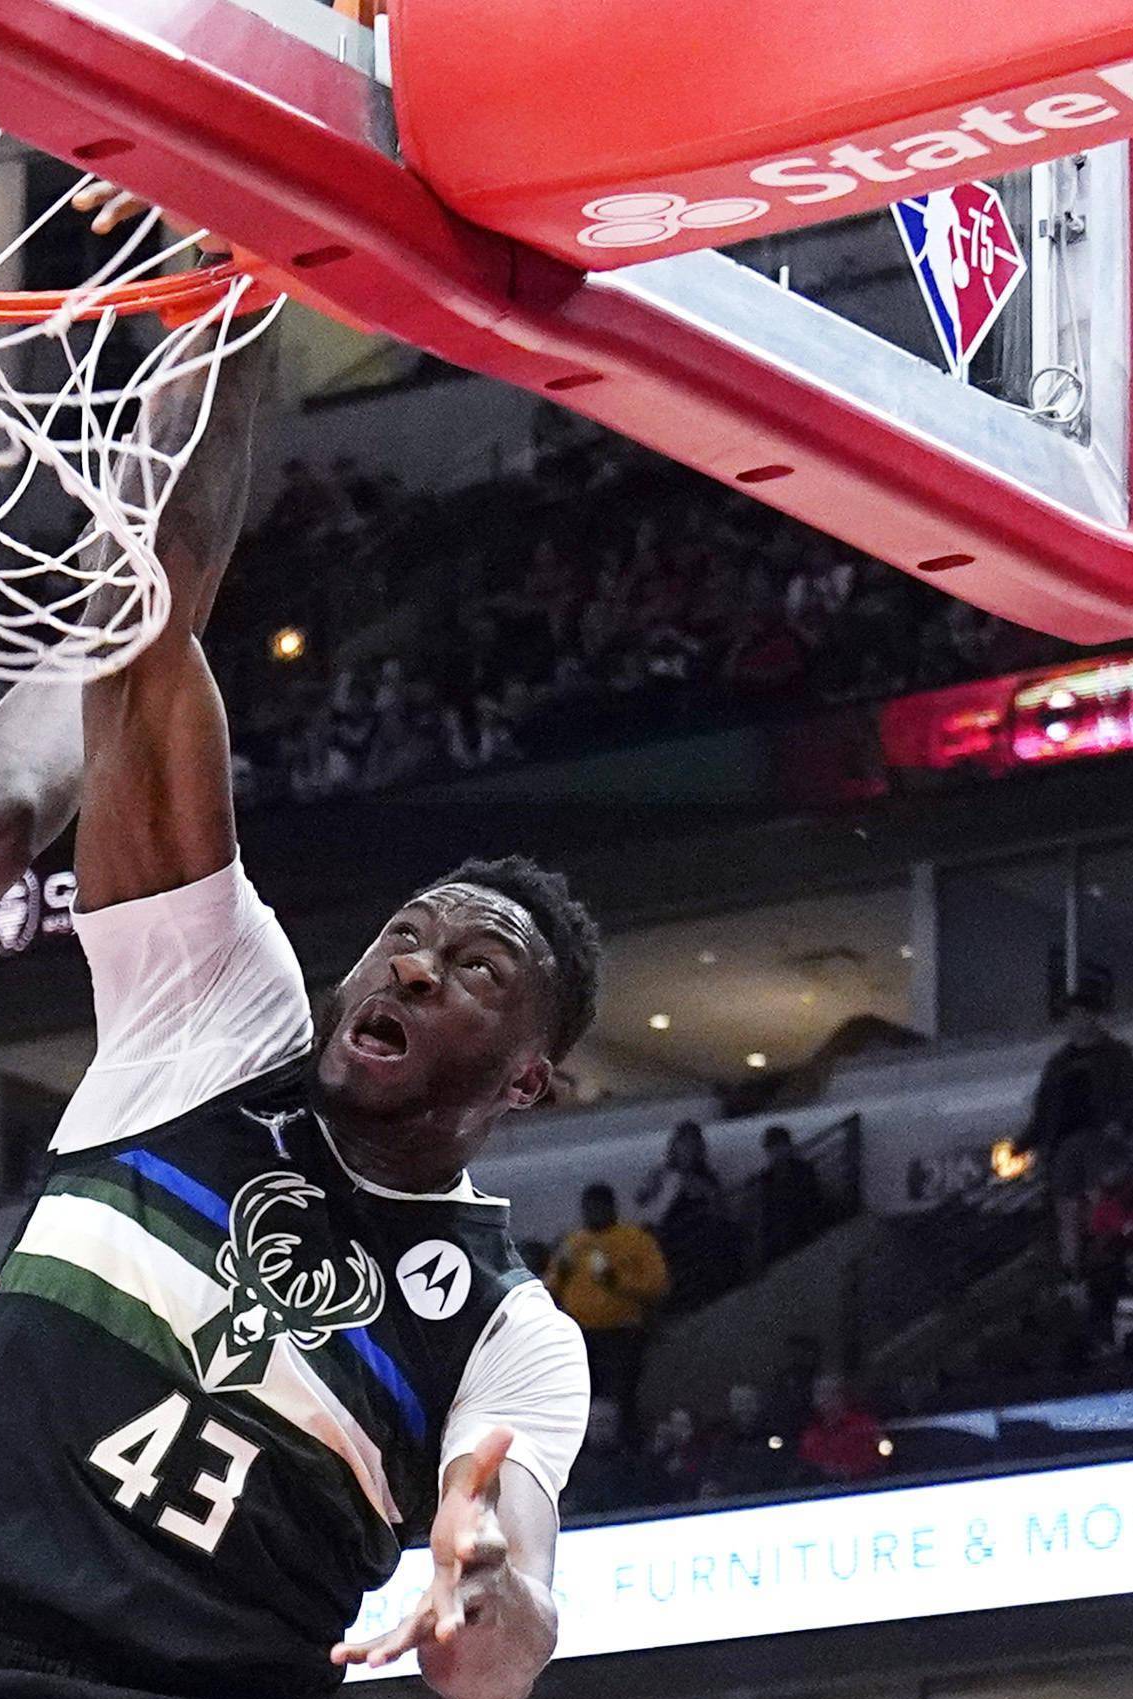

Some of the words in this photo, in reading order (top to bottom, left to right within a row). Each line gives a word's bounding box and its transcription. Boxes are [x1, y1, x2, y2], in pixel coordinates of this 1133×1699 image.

[750, 93, 1120, 205] State
[968, 206, 994, 276] 75
[83, 1388, 265, 1557] 43
[614, 1527, 937, 1603] FURNITURE
[964, 1518, 996, 1565] &
